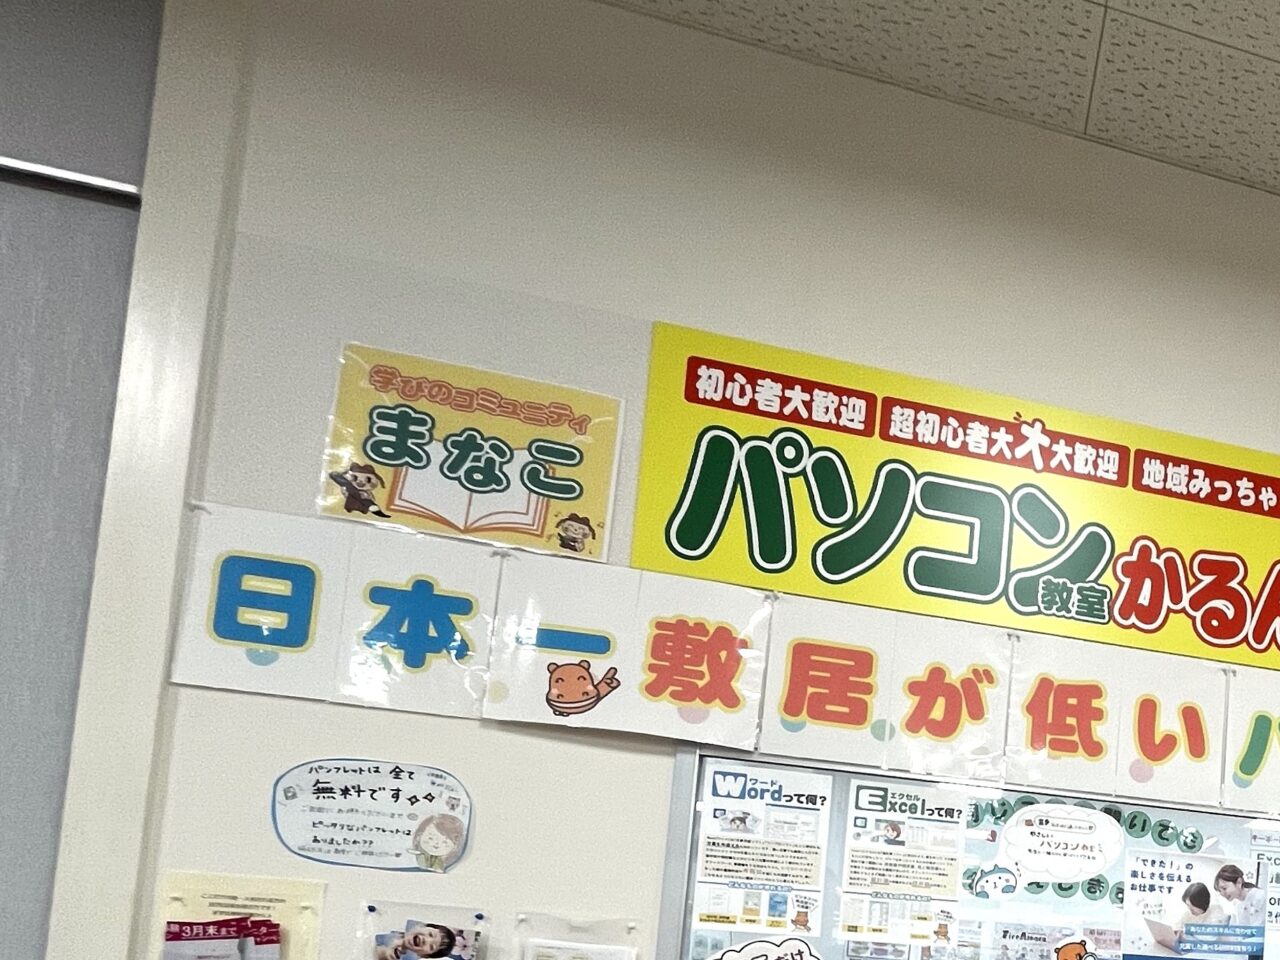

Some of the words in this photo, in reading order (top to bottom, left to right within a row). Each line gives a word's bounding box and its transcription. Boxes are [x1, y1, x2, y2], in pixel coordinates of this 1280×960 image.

[369, 363, 591, 436] 学びのコミュニティ
[695, 363, 868, 432] 初心者大歓迎
[363, 403, 584, 501] まなこ
[665, 424, 1117, 616] パソコン
[1036, 575, 1112, 625] 教室
[308, 766, 381, 775] パンフレットは
[389, 765, 416, 781] 全て
[312, 779, 403, 803] 無料です
[1130, 870, 1192, 882] 楽しさを伝える
[1130, 883, 1174, 894] お仕事です
